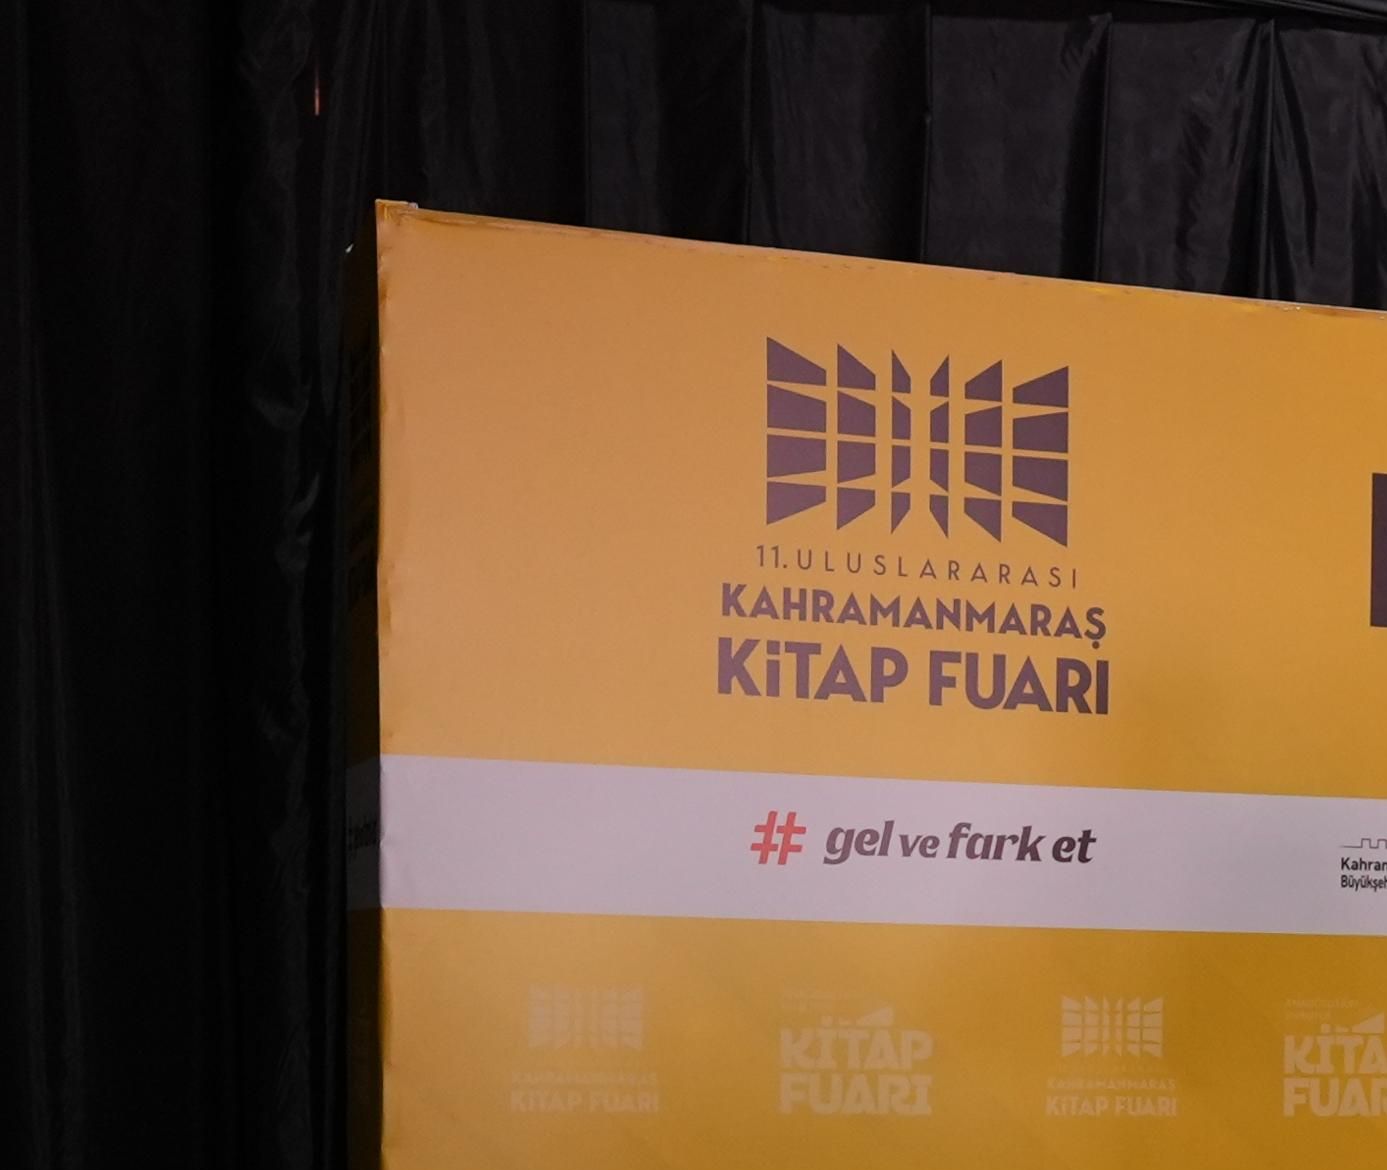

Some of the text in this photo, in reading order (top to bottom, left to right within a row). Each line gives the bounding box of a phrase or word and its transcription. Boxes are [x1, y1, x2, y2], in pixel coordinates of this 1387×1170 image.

[721, 583, 1107, 649] KAHRAMANMARAŞ
[928, 649, 1109, 715] FUARI
[823, 820, 895, 865] gel
[899, 829, 940, 858] ve
[946, 822, 1046, 862] fark
[1051, 829, 1097, 864] et
[780, 1073, 932, 1115] FUARI
